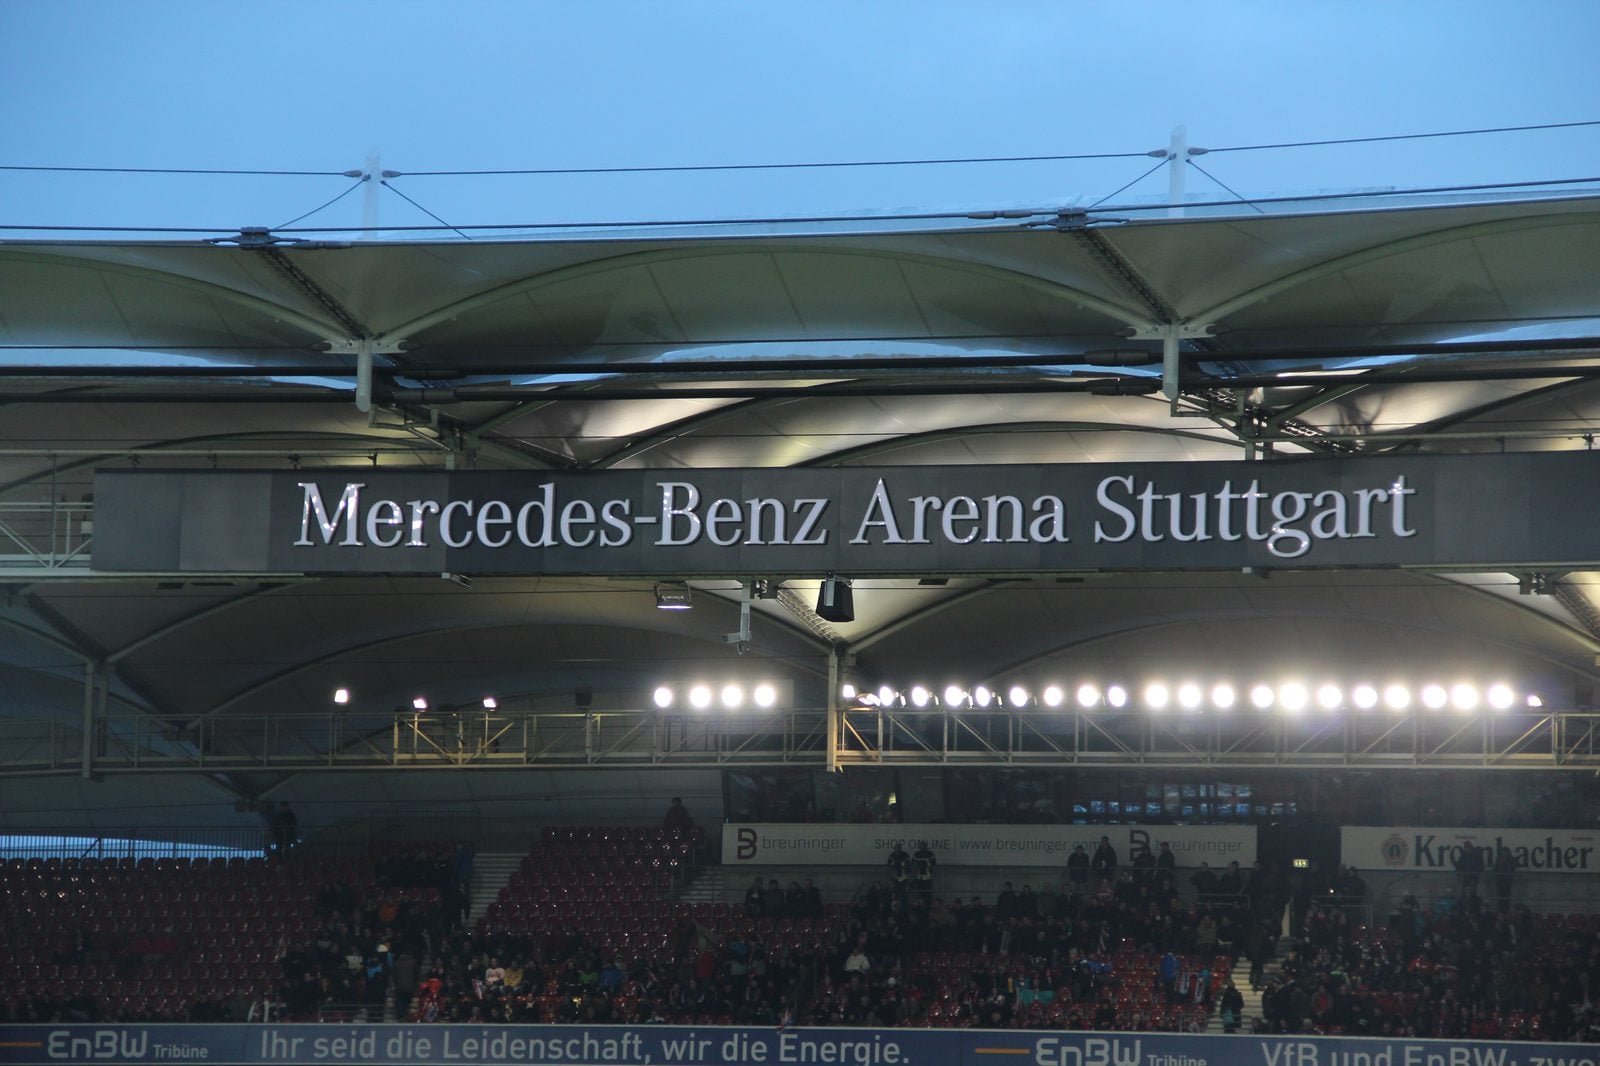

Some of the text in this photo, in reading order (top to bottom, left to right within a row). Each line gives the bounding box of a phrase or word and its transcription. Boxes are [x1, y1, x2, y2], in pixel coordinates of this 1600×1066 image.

[294, 474, 1417, 558] Mercedes-Benz Arena Stuttgart
[762, 836, 847, 853] breuninger
[1156, 838, 1243, 855] beuninger
[47, 1030, 208, 1059] EnBW Tribüne
[261, 1030, 910, 1066] Ihr seid die Leidenschaft, wir die Energie.
[1035, 1037, 1141, 1066] EnBW
[1261, 1042, 1318, 1066] VfB
[1331, 1045, 1392, 1066] und
